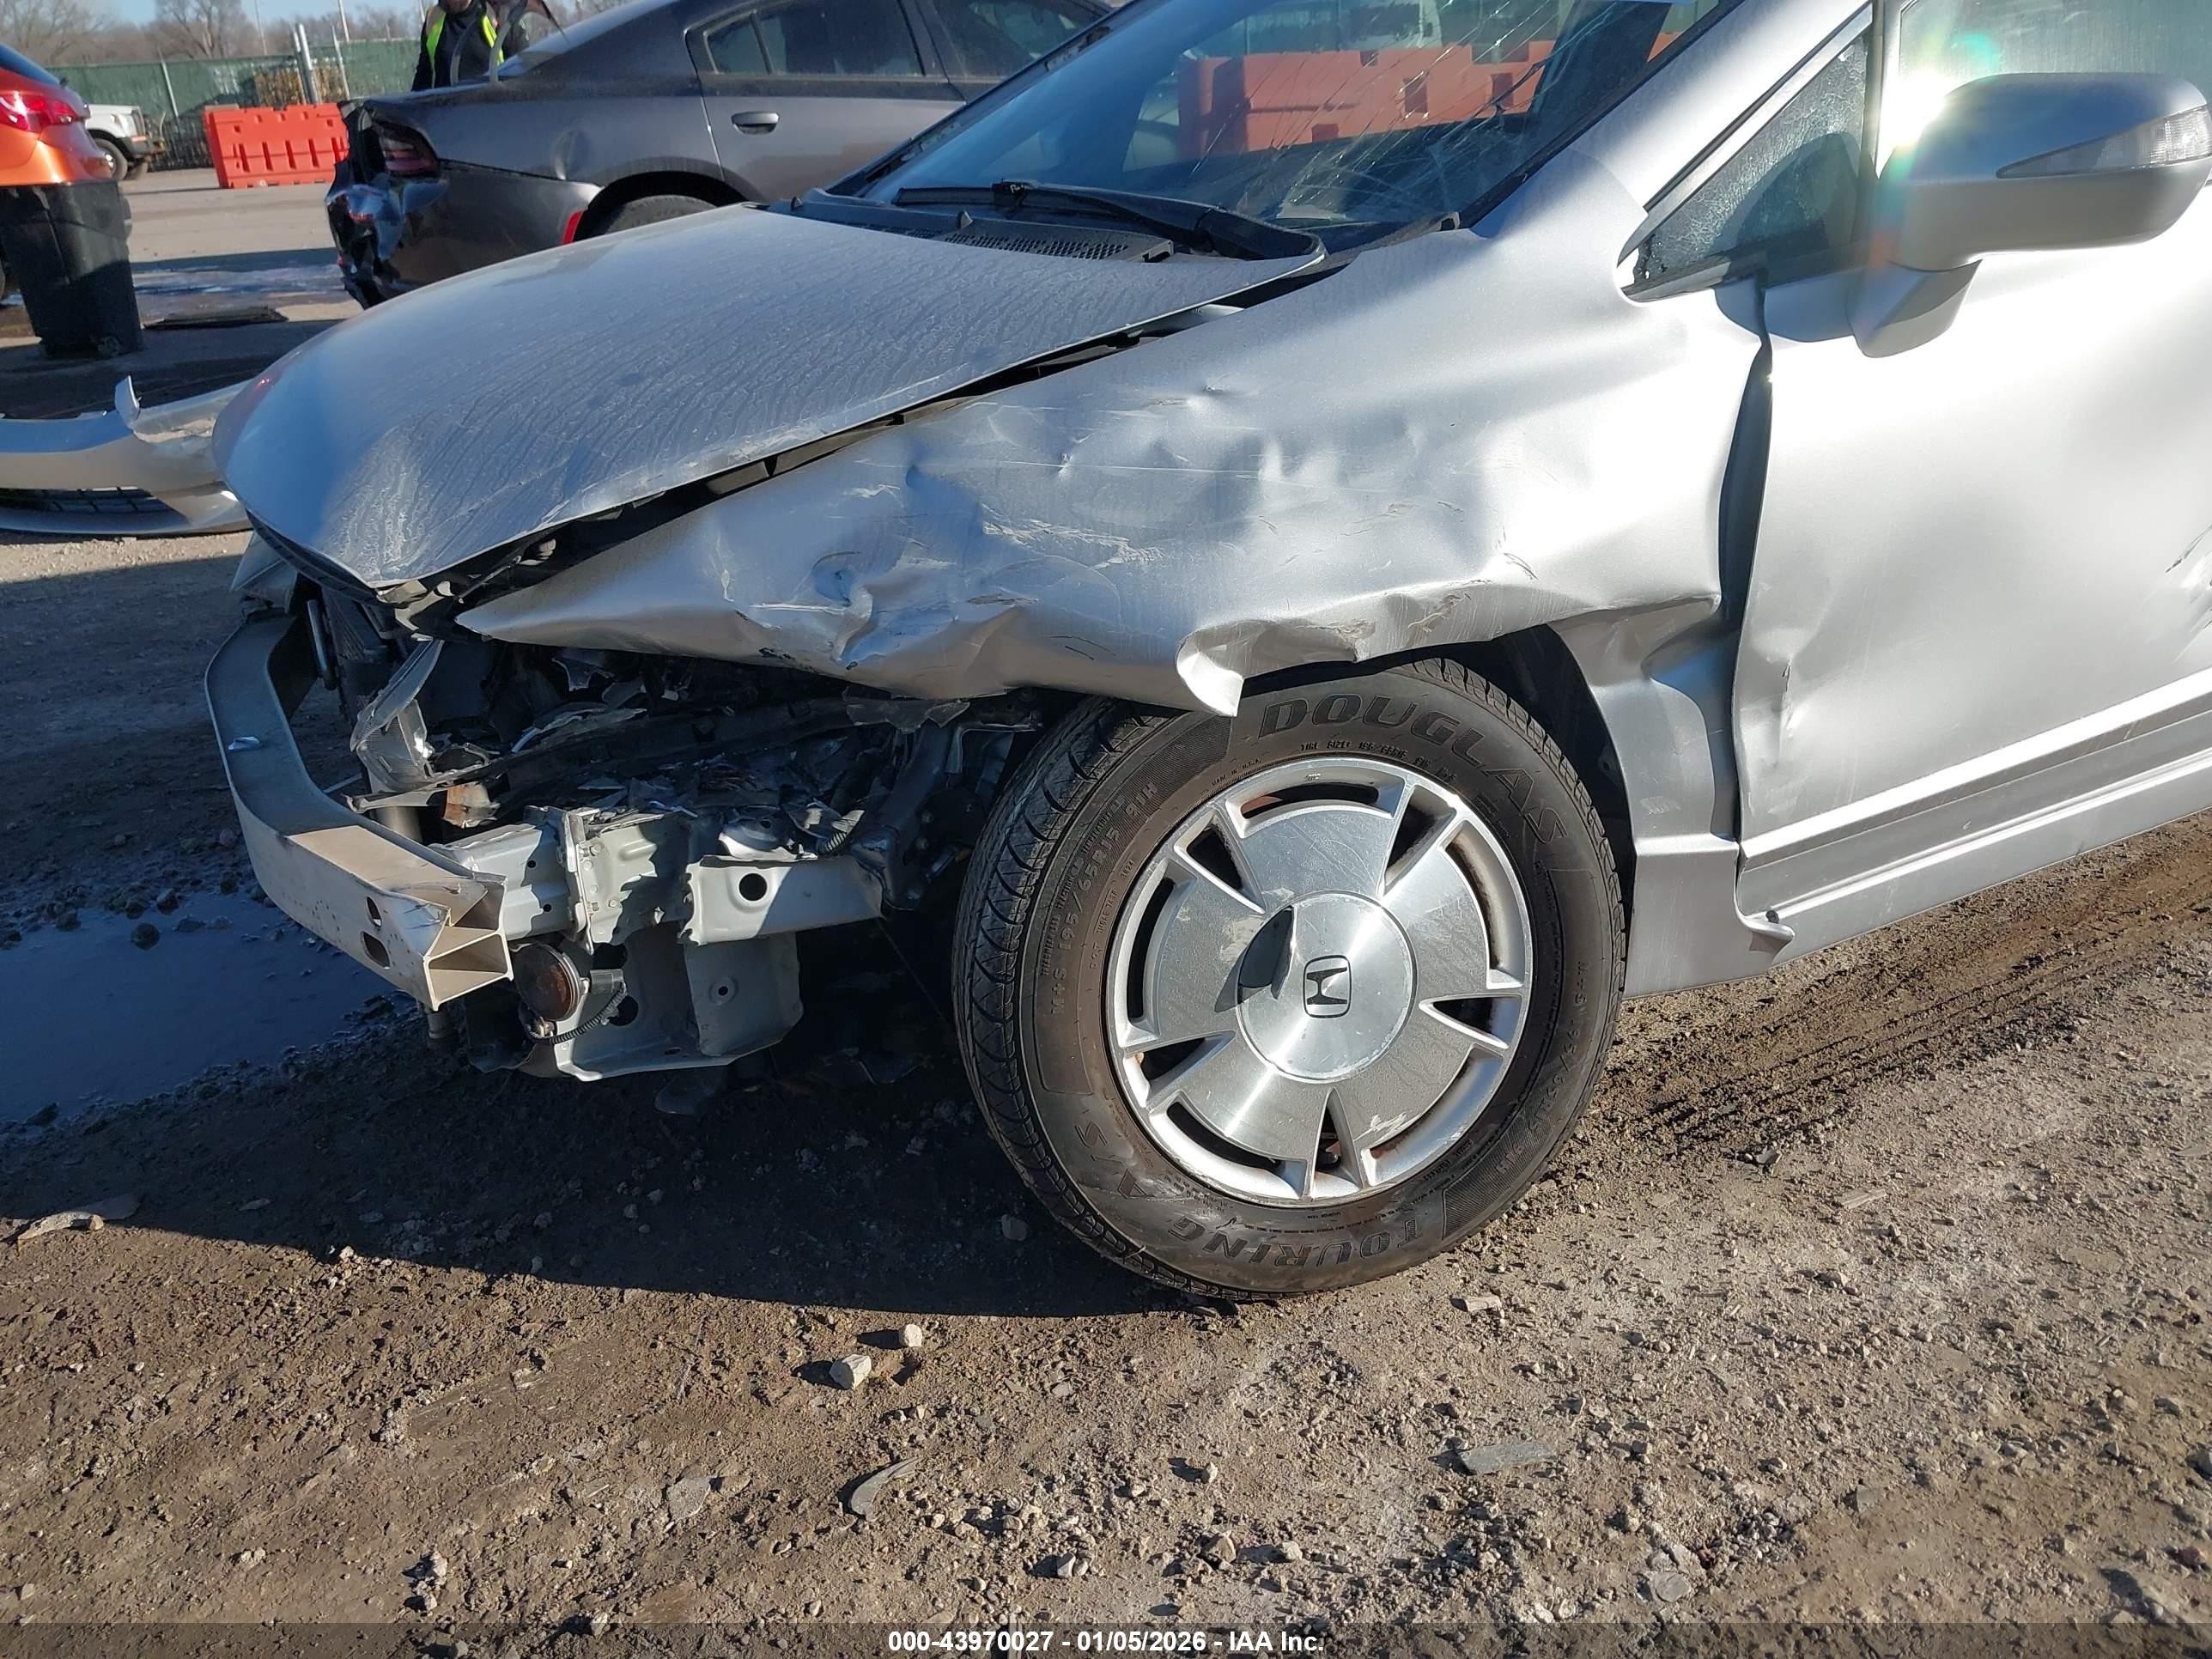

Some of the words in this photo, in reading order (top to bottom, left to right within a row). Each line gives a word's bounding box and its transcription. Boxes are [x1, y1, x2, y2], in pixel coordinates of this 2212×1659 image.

[1259, 693, 1568, 845] DOUGLAS
[1058, 827, 1121, 950] 195/65R15
[1124, 781, 1158, 817] 91H
[1074, 1121, 1156, 1200] A/S
[1168, 1215, 1425, 1268] TOURING
